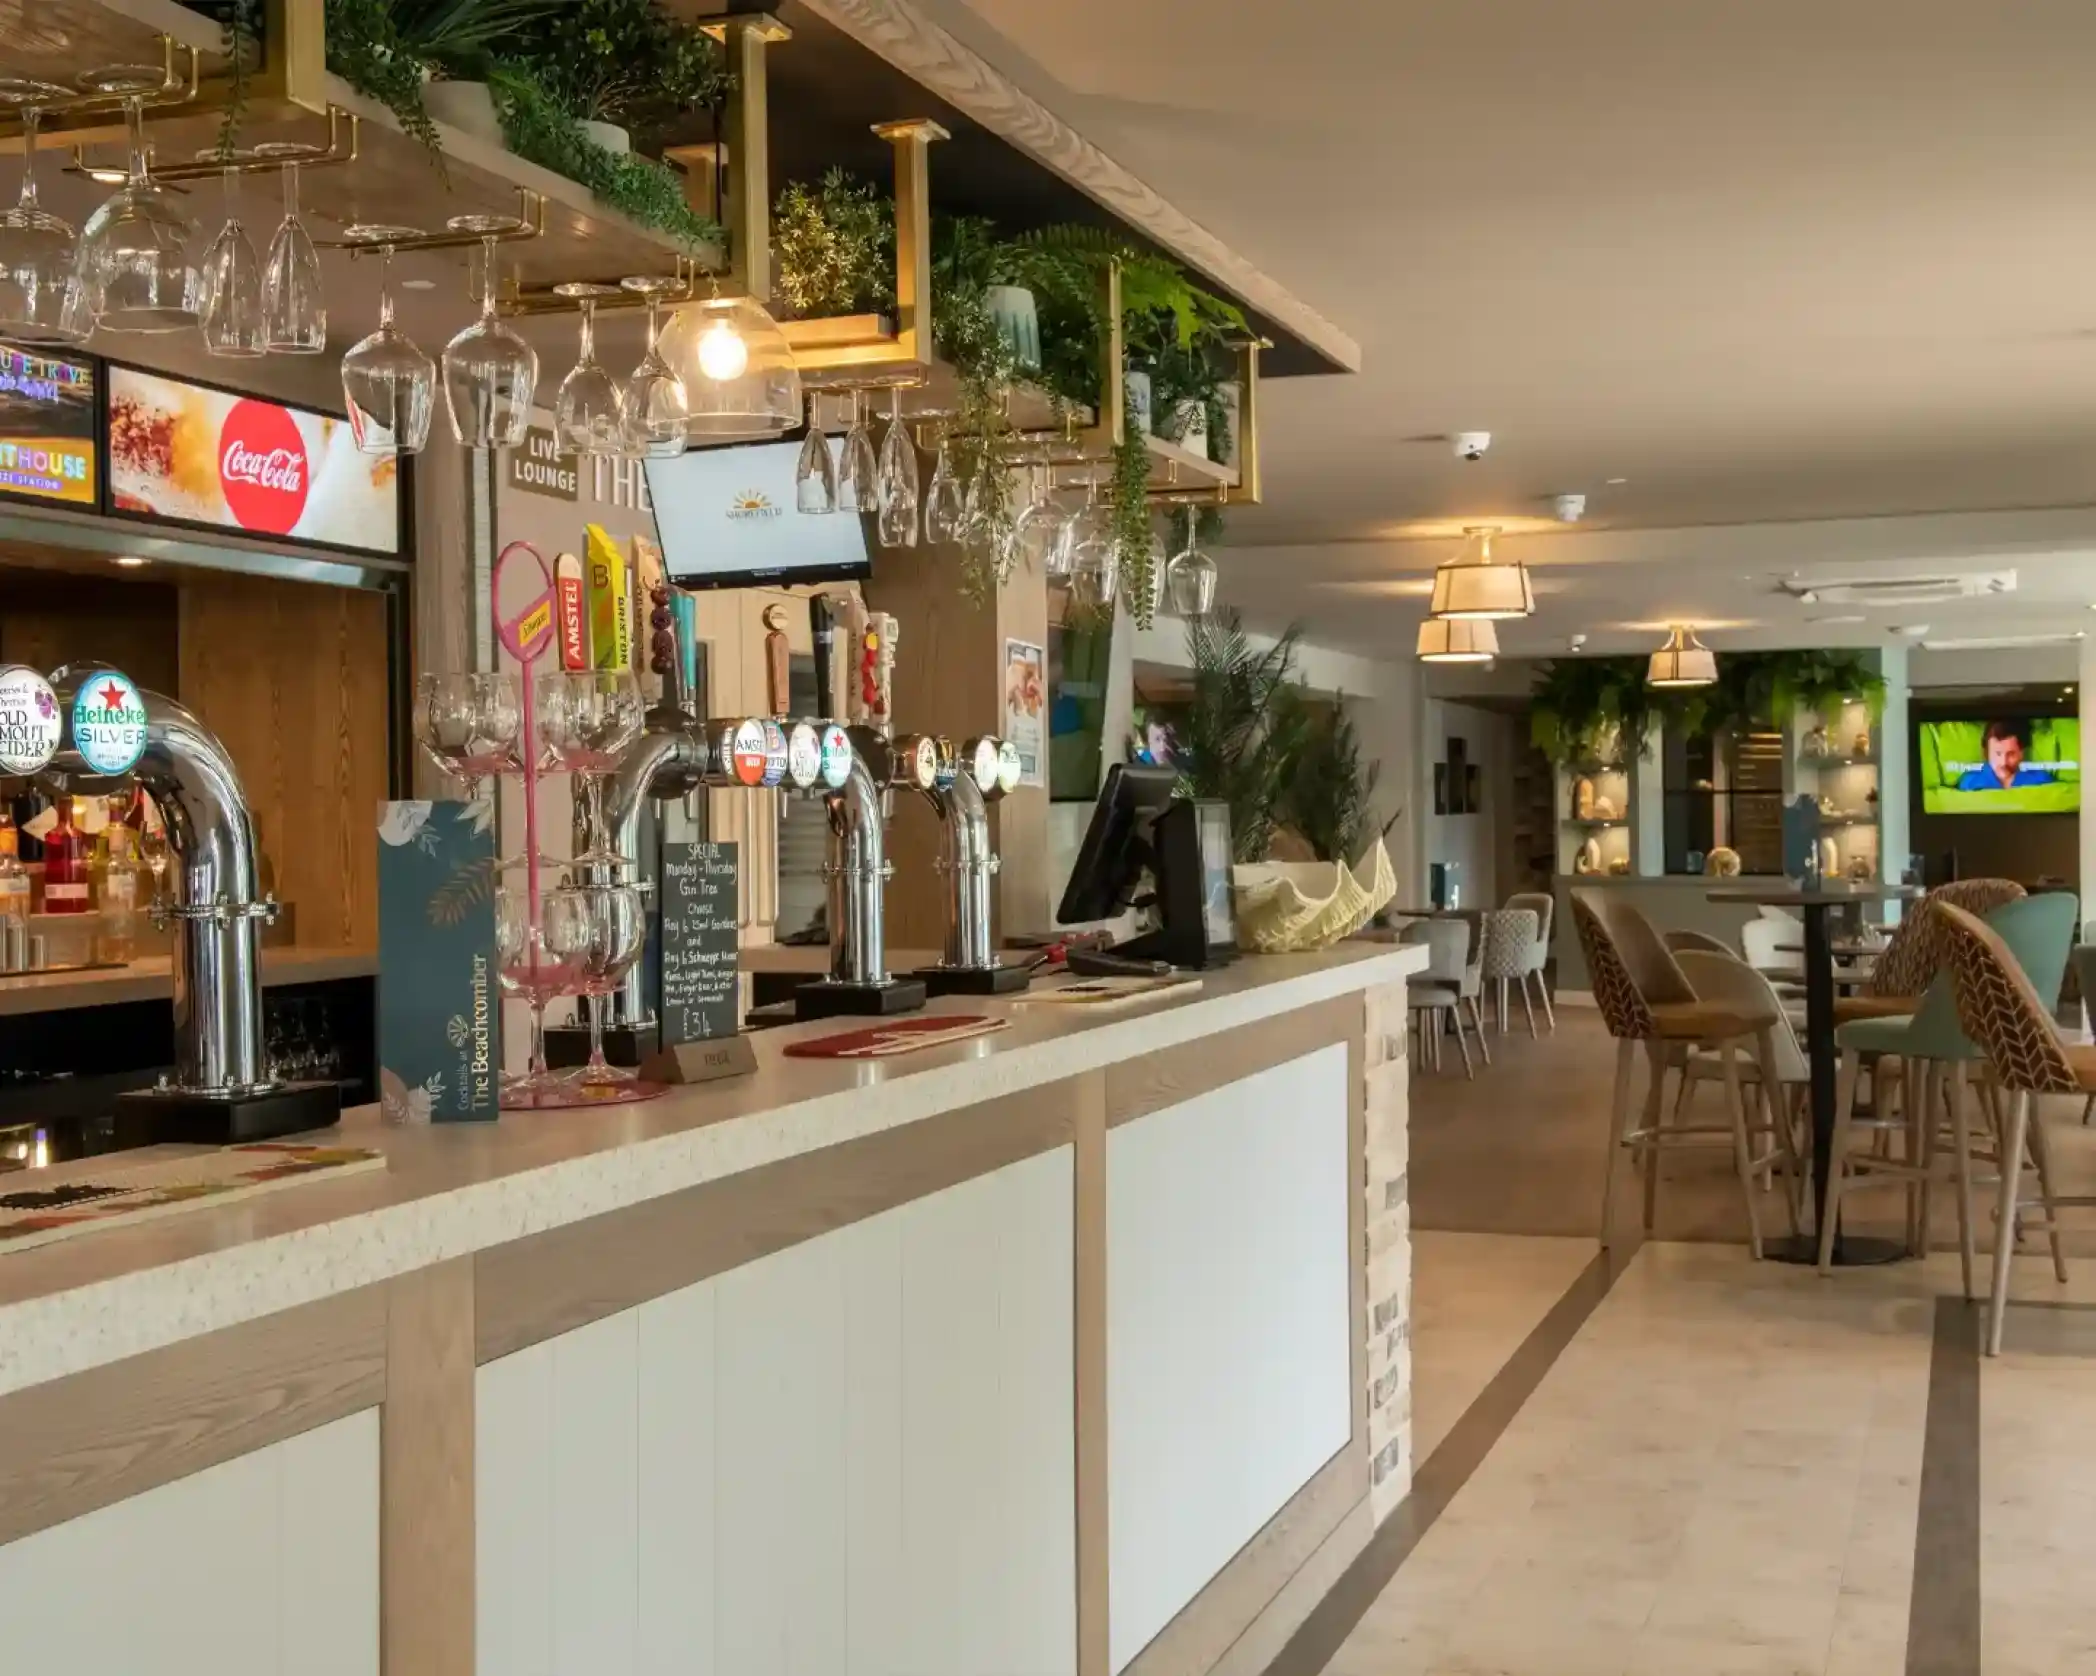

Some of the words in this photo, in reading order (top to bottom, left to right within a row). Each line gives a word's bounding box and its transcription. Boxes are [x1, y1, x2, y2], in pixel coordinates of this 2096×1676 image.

[0, 441, 87, 480] THOUSE
[223, 440, 304, 492] Coca-Cola
[530, 436, 562, 463] LIVE
[514, 459, 577, 493] LOUNGE
[565, 582, 583, 662] AMSTEL
[73, 705, 147, 725] Heineke
[688, 843, 721, 860] SPECIAL
[680, 877, 697, 896] Gin
[664, 916, 679, 940] Any
[470, 953, 489, 1075] Beachcomber
[470, 1076, 490, 1113] The
